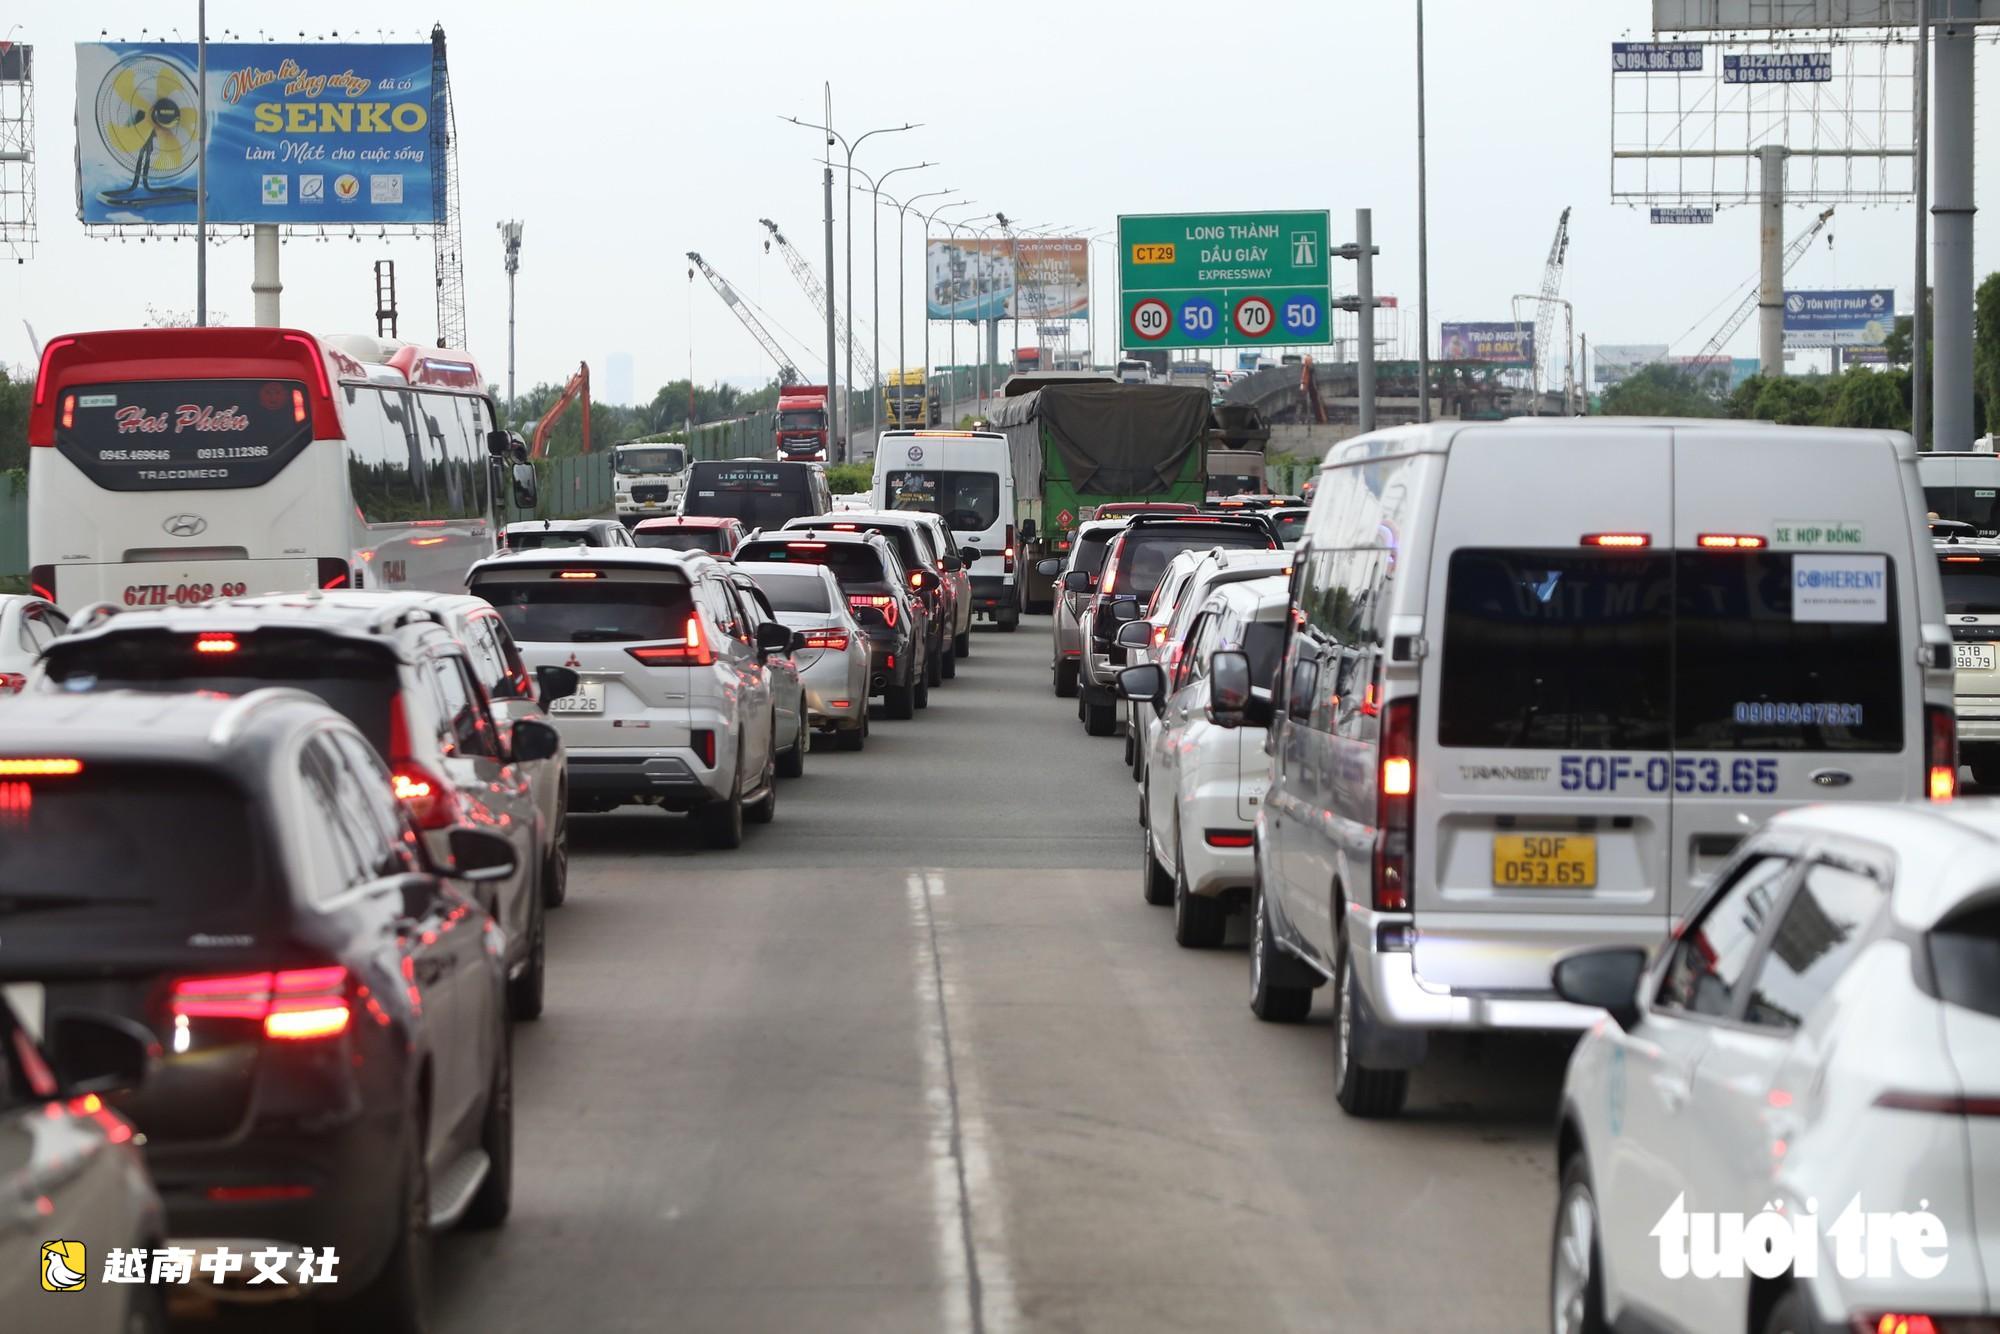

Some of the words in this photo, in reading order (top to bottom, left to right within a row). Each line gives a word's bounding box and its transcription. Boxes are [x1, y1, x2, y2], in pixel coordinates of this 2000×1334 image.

[1627, 52, 1701, 69] 094.986.98.98
[1739, 53, 1830, 67] BIZMAN.VN
[223, 66, 276, 104] Mùa
[278, 59, 299, 80] hè
[378, 78, 395, 90] đã
[397, 78, 412, 90] có
[1740, 67, 1831, 82] 094.986.98.98
[254, 102, 428, 133] SENKO
[246, 146, 276, 160] Làm
[279, 139, 325, 164] Mát
[331, 147, 355, 160] cho
[360, 147, 391, 163] cuộc
[394, 146, 425, 162] sống
[1185, 225, 1225, 241] LONG
[1228, 222, 1280, 240] THÀNH
[1136, 247, 1174, 261] CT.29
[1235, 245, 1269, 262] GIÂY
[1198, 268, 1273, 281] EXPRESSWAY
[1806, 298, 1824, 310] TÔN
[1824, 297, 1842, 312] VIỆT
[1844, 296, 1867, 309] PHÁP
[1141, 309, 1163, 329] 90
[1184, 306, 1213, 330] 50
[1244, 307, 1265, 327] 70
[1287, 304, 1316, 328] 50
[115, 405, 169, 434] Hai
[138, 468, 228, 479] TRACOMECO
[1776, 527, 1790, 542] XE
[1796, 525, 1822, 545] HỢP
[1797, 569, 1883, 589] COHERENT
[1958, 646, 1980, 656] 51B
[1458, 765, 1552, 780] TRANSIT
[1560, 755, 1778, 794] 50F-053.65
[1523, 836, 1567, 859] 50F
[1504, 862, 1586, 883] 053.65
